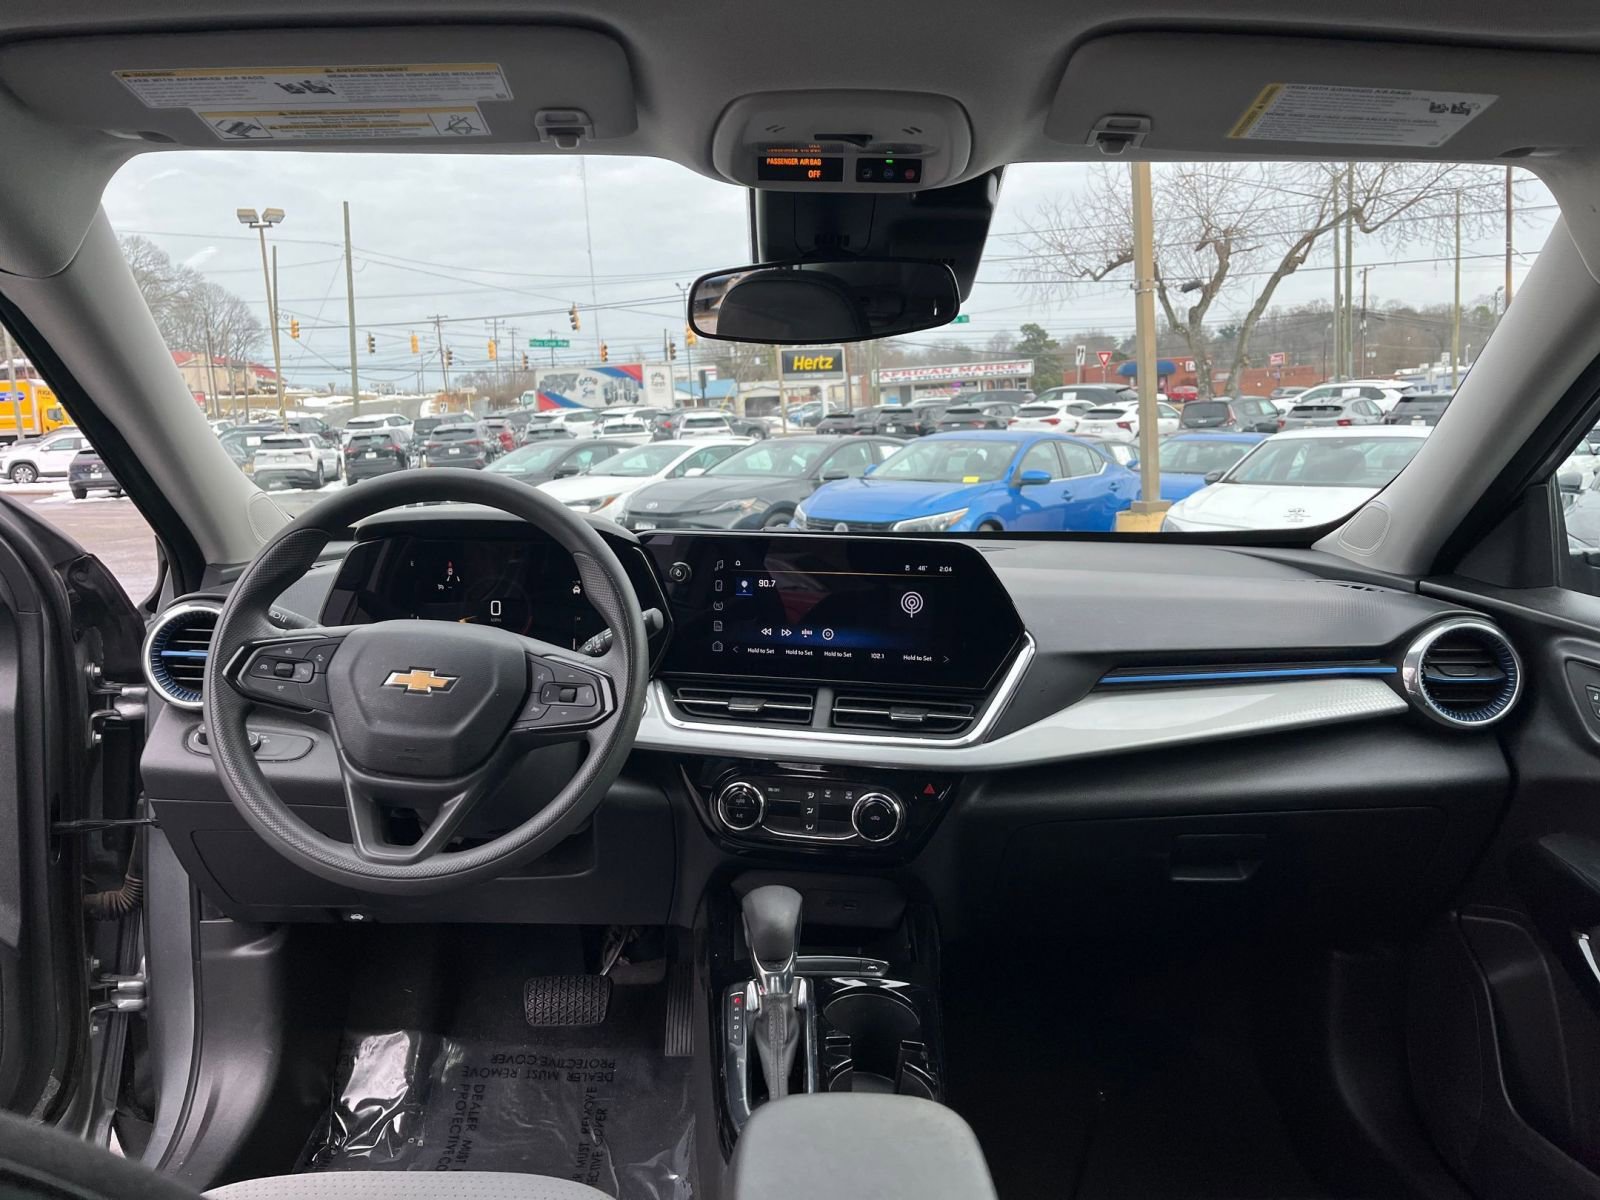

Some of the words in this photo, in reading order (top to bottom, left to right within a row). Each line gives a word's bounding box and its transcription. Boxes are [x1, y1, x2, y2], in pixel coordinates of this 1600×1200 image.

[808, 170, 821, 178] OFF
[793, 354, 833, 370] Hertz
[880, 368, 951, 378] AFRICAN
[959, 362, 1028, 372] MARKET
[758, 580, 776, 588] 90.7
[490, 600, 501, 616] 0
[490, 1054, 537, 1066] COVER
[540, 1054, 616, 1069] PROTECTIVE
[462, 1066, 518, 1079] REMOVE
[526, 1070, 560, 1080] MUST
[566, 1070, 615, 1082] DEALER
[465, 1084, 485, 1131] DEALER
[443, 1084, 470, 1155] PROTECTIVE
[576, 1142, 590, 1168] MUST
[587, 1151, 603, 1183] ECTIVE
